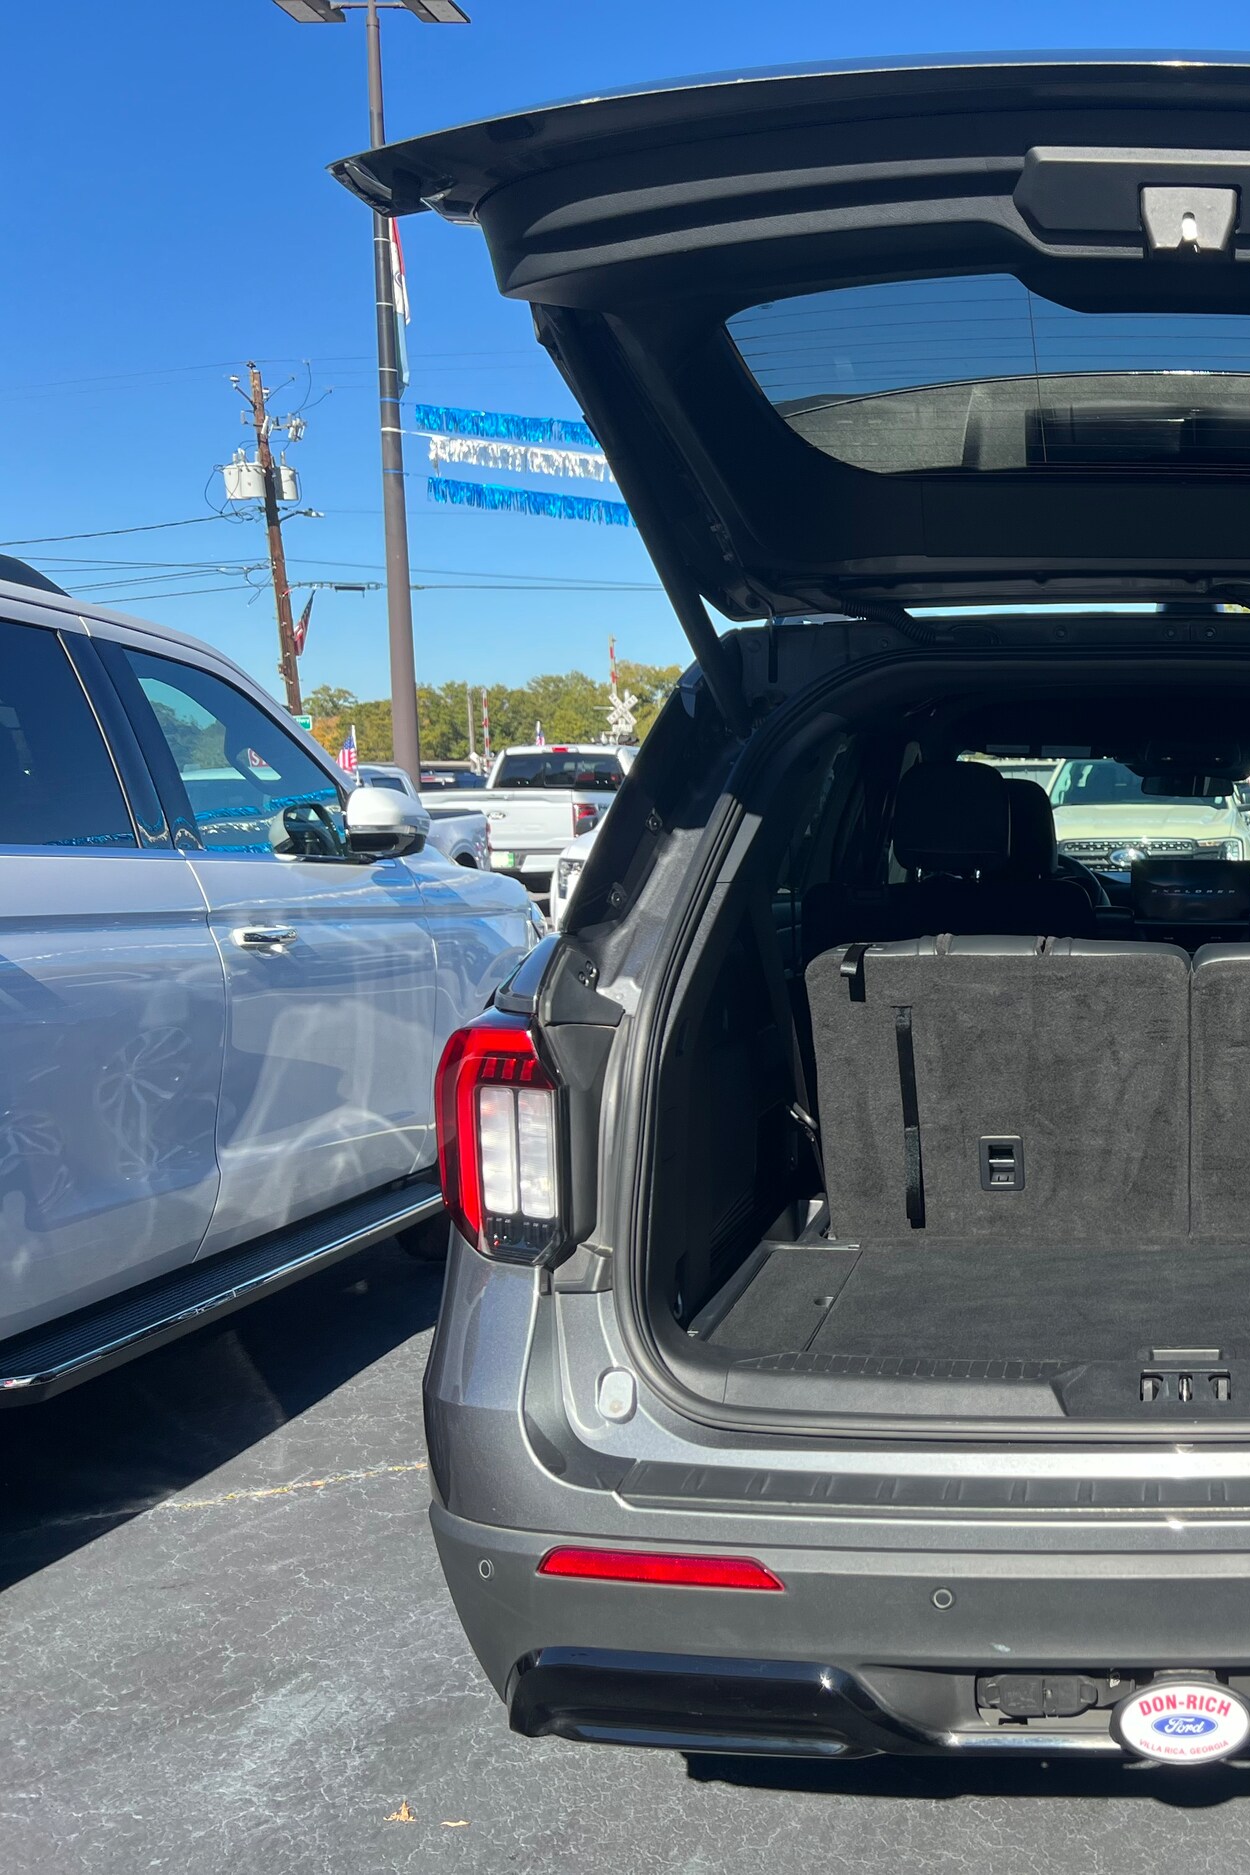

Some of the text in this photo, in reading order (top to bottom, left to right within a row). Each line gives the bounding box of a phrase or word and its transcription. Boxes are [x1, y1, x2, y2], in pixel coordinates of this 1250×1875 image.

[1139, 1694, 1230, 1716] DON-RICH
[1164, 1717, 1204, 1734] Ford
[1139, 1738, 1162, 1753] VILLA
[1190, 1740, 1229, 1755] GEORGIA
